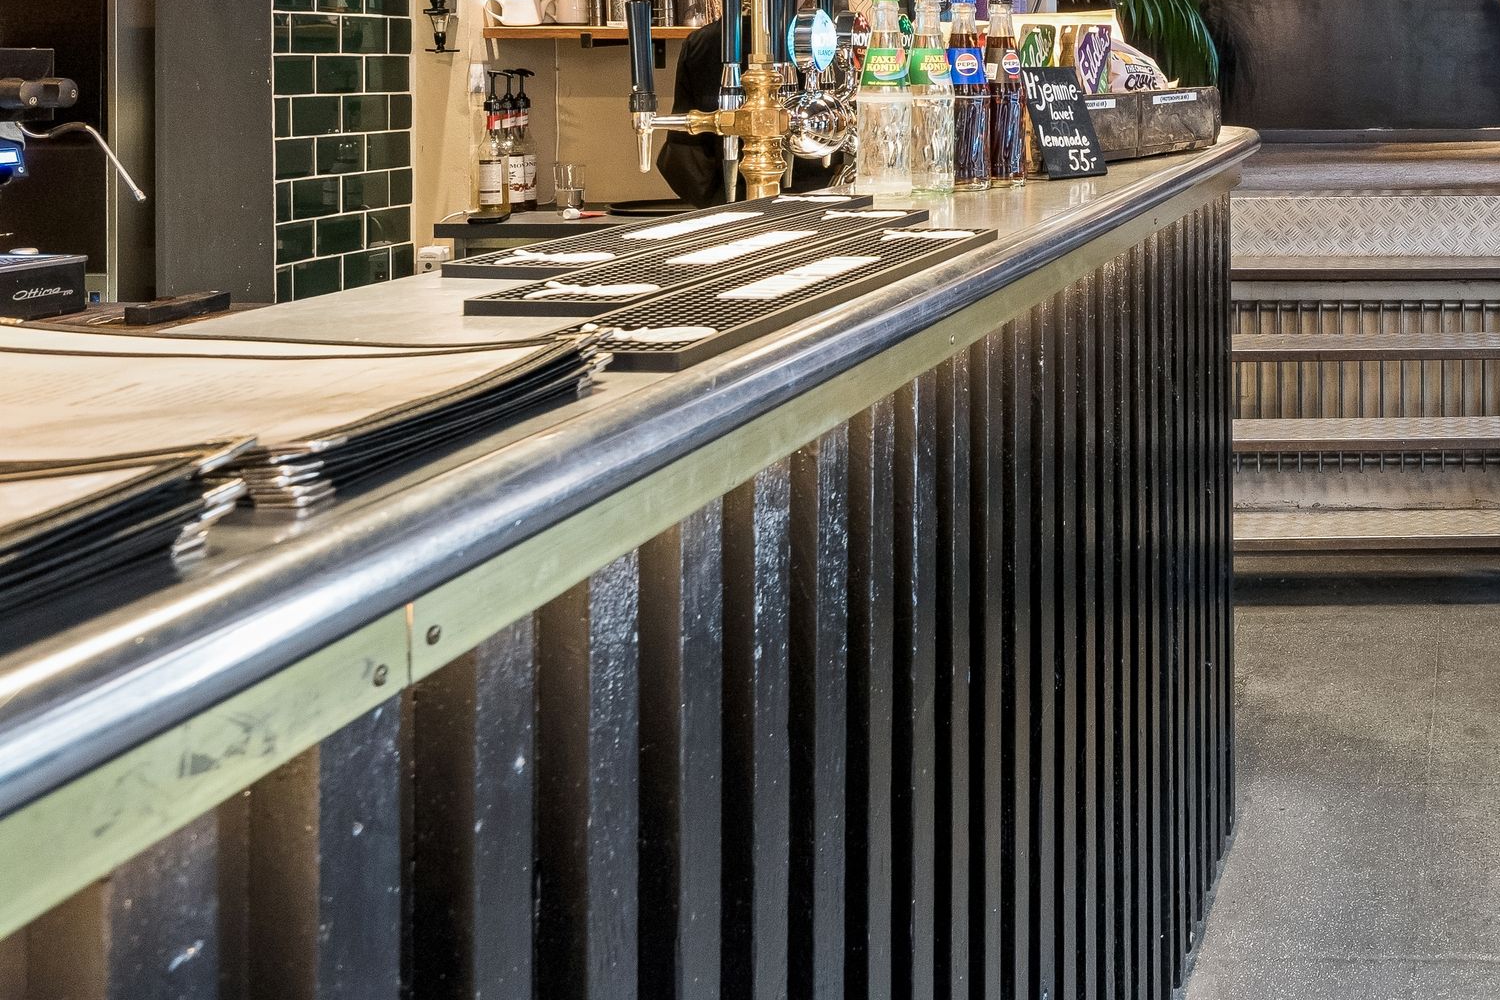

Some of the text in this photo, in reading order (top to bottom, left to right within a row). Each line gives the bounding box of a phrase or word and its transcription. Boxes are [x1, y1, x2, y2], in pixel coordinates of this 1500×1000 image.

[853, 33, 868, 46] ROY
[1022, 70, 1081, 111] Hjemme-
[1050, 104, 1074, 121] lavet
[13, 287, 61, 300] Ottima
